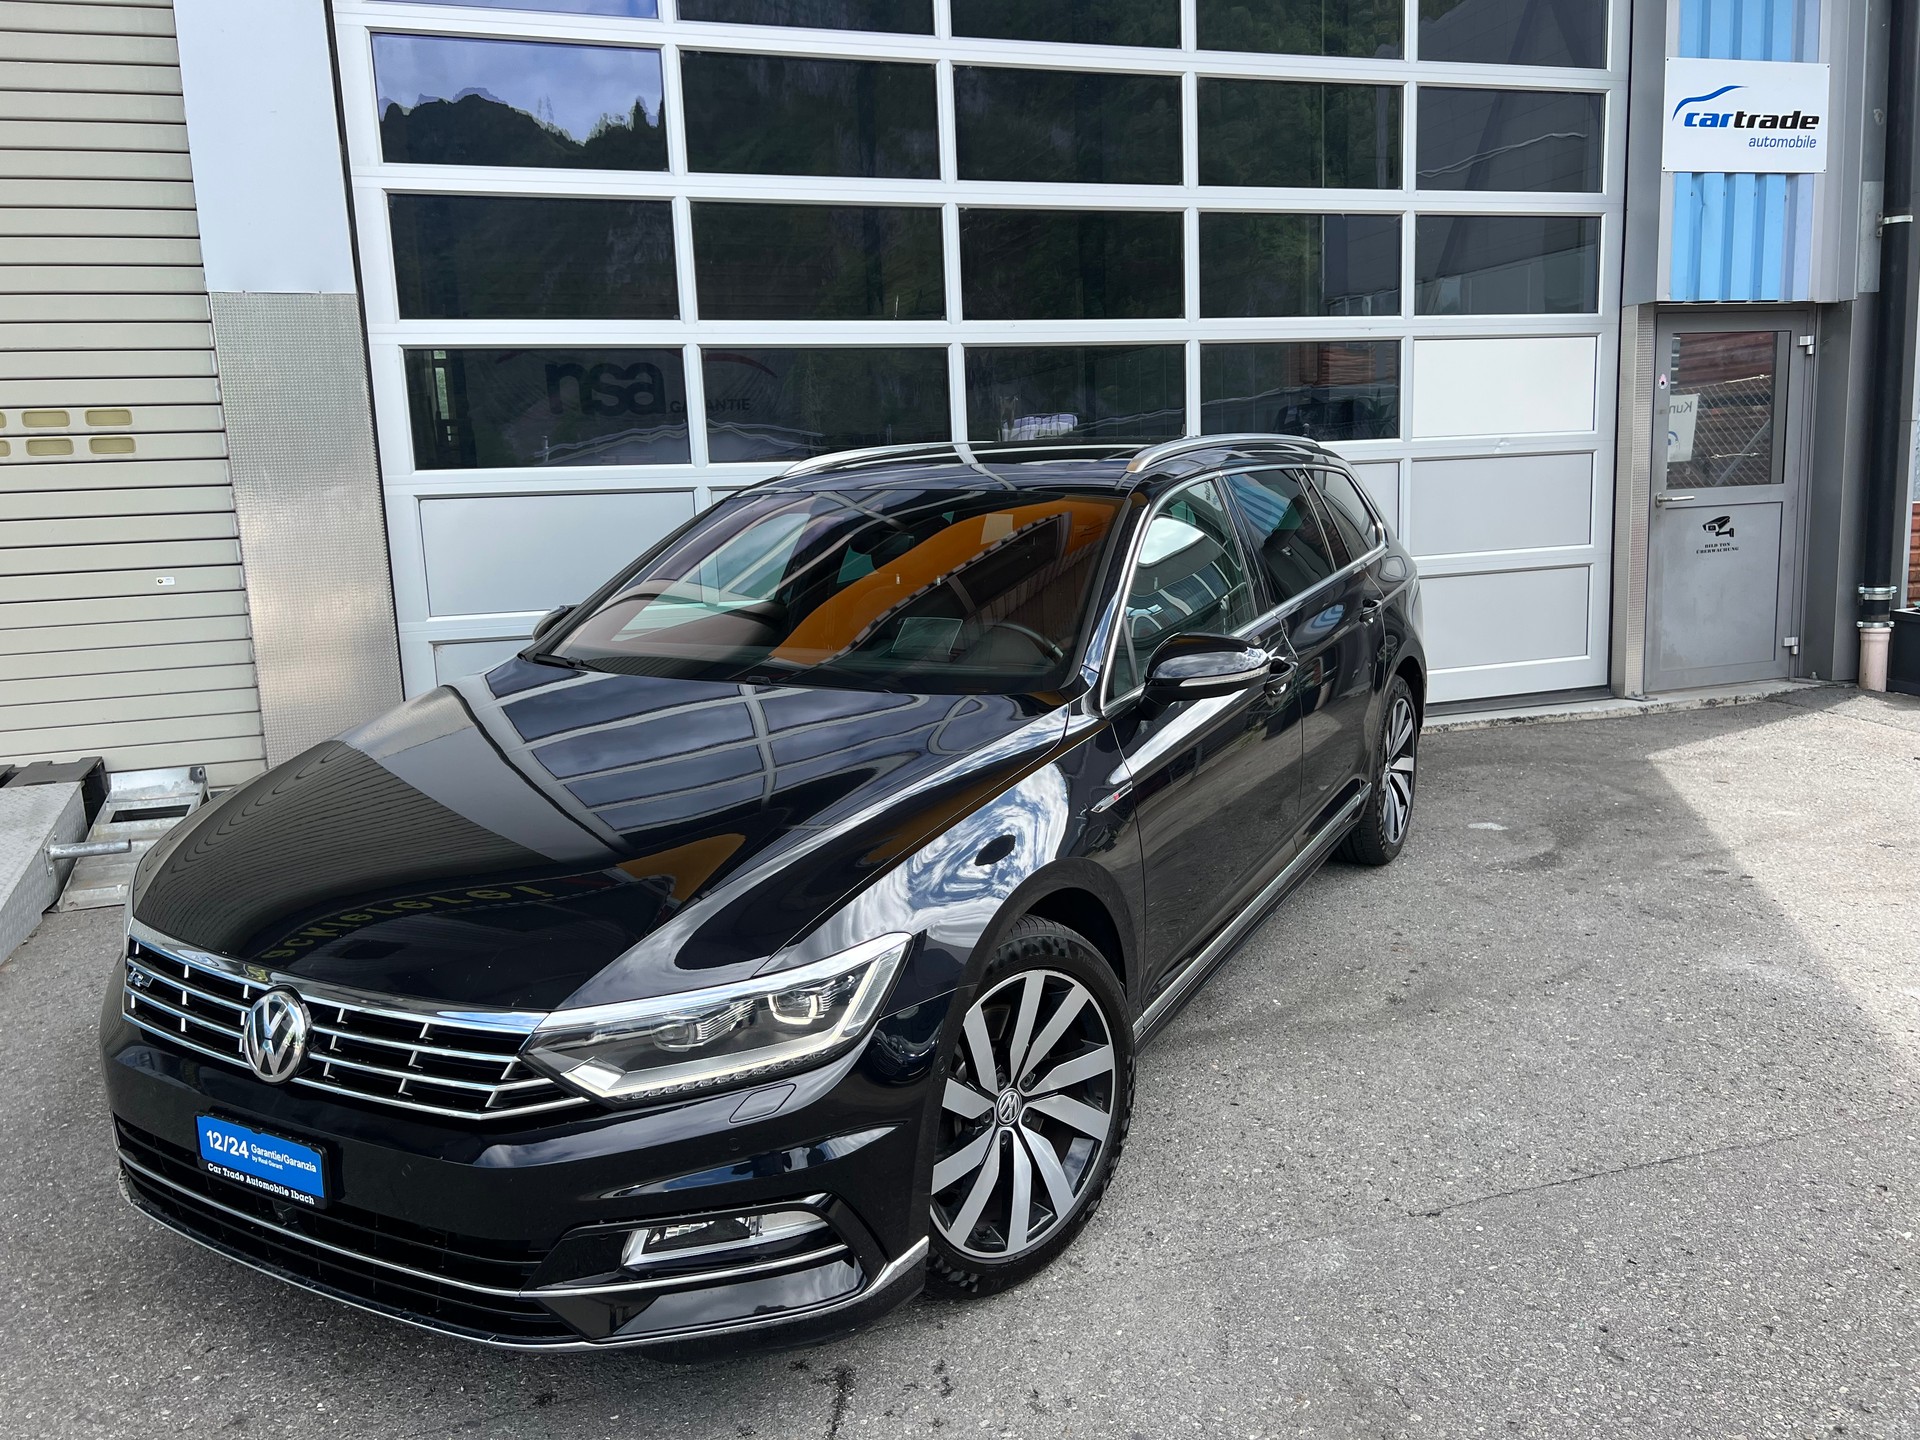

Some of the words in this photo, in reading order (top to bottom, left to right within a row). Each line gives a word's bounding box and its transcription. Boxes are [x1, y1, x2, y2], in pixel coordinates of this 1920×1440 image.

[1683, 111, 1820, 130] cartrade
[1748, 135, 1817, 149] automobile
[545, 362, 666, 416] nsa
[669, 398, 751, 414] GAANTIE
[206, 1129, 249, 1159] 12/24
[250, 1143, 317, 1173] Garantie/Garanzia
[251, 1155, 258, 1163] by
[207, 1163, 222, 1175] Car
[222, 1168, 245, 1182] Trade
[246, 1175, 289, 1197] Automobile
[290, 1190, 315, 1205] Ibach
